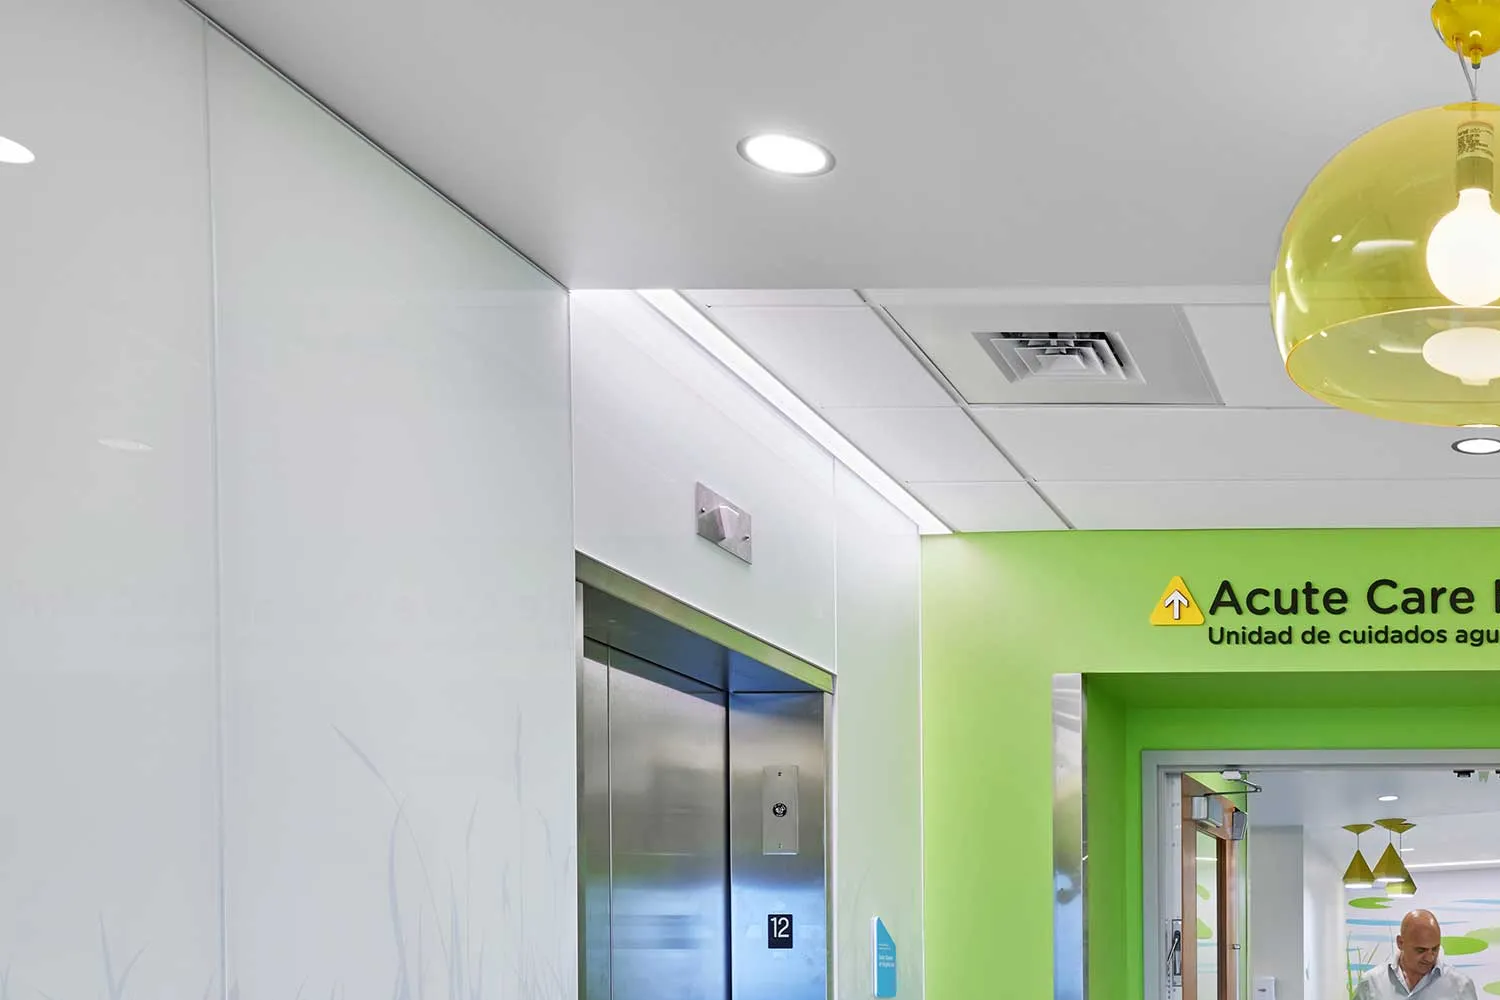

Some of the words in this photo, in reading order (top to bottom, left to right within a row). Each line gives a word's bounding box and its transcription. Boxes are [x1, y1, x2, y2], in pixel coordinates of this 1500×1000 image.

[1208, 579, 1348, 615] Acute
[1366, 578, 1475, 614] Care
[1208, 626, 1293, 645] Unidad
[1301, 626, 1331, 645] de
[1338, 625, 1448, 644] cuidados
[770, 917, 790, 938] 12
